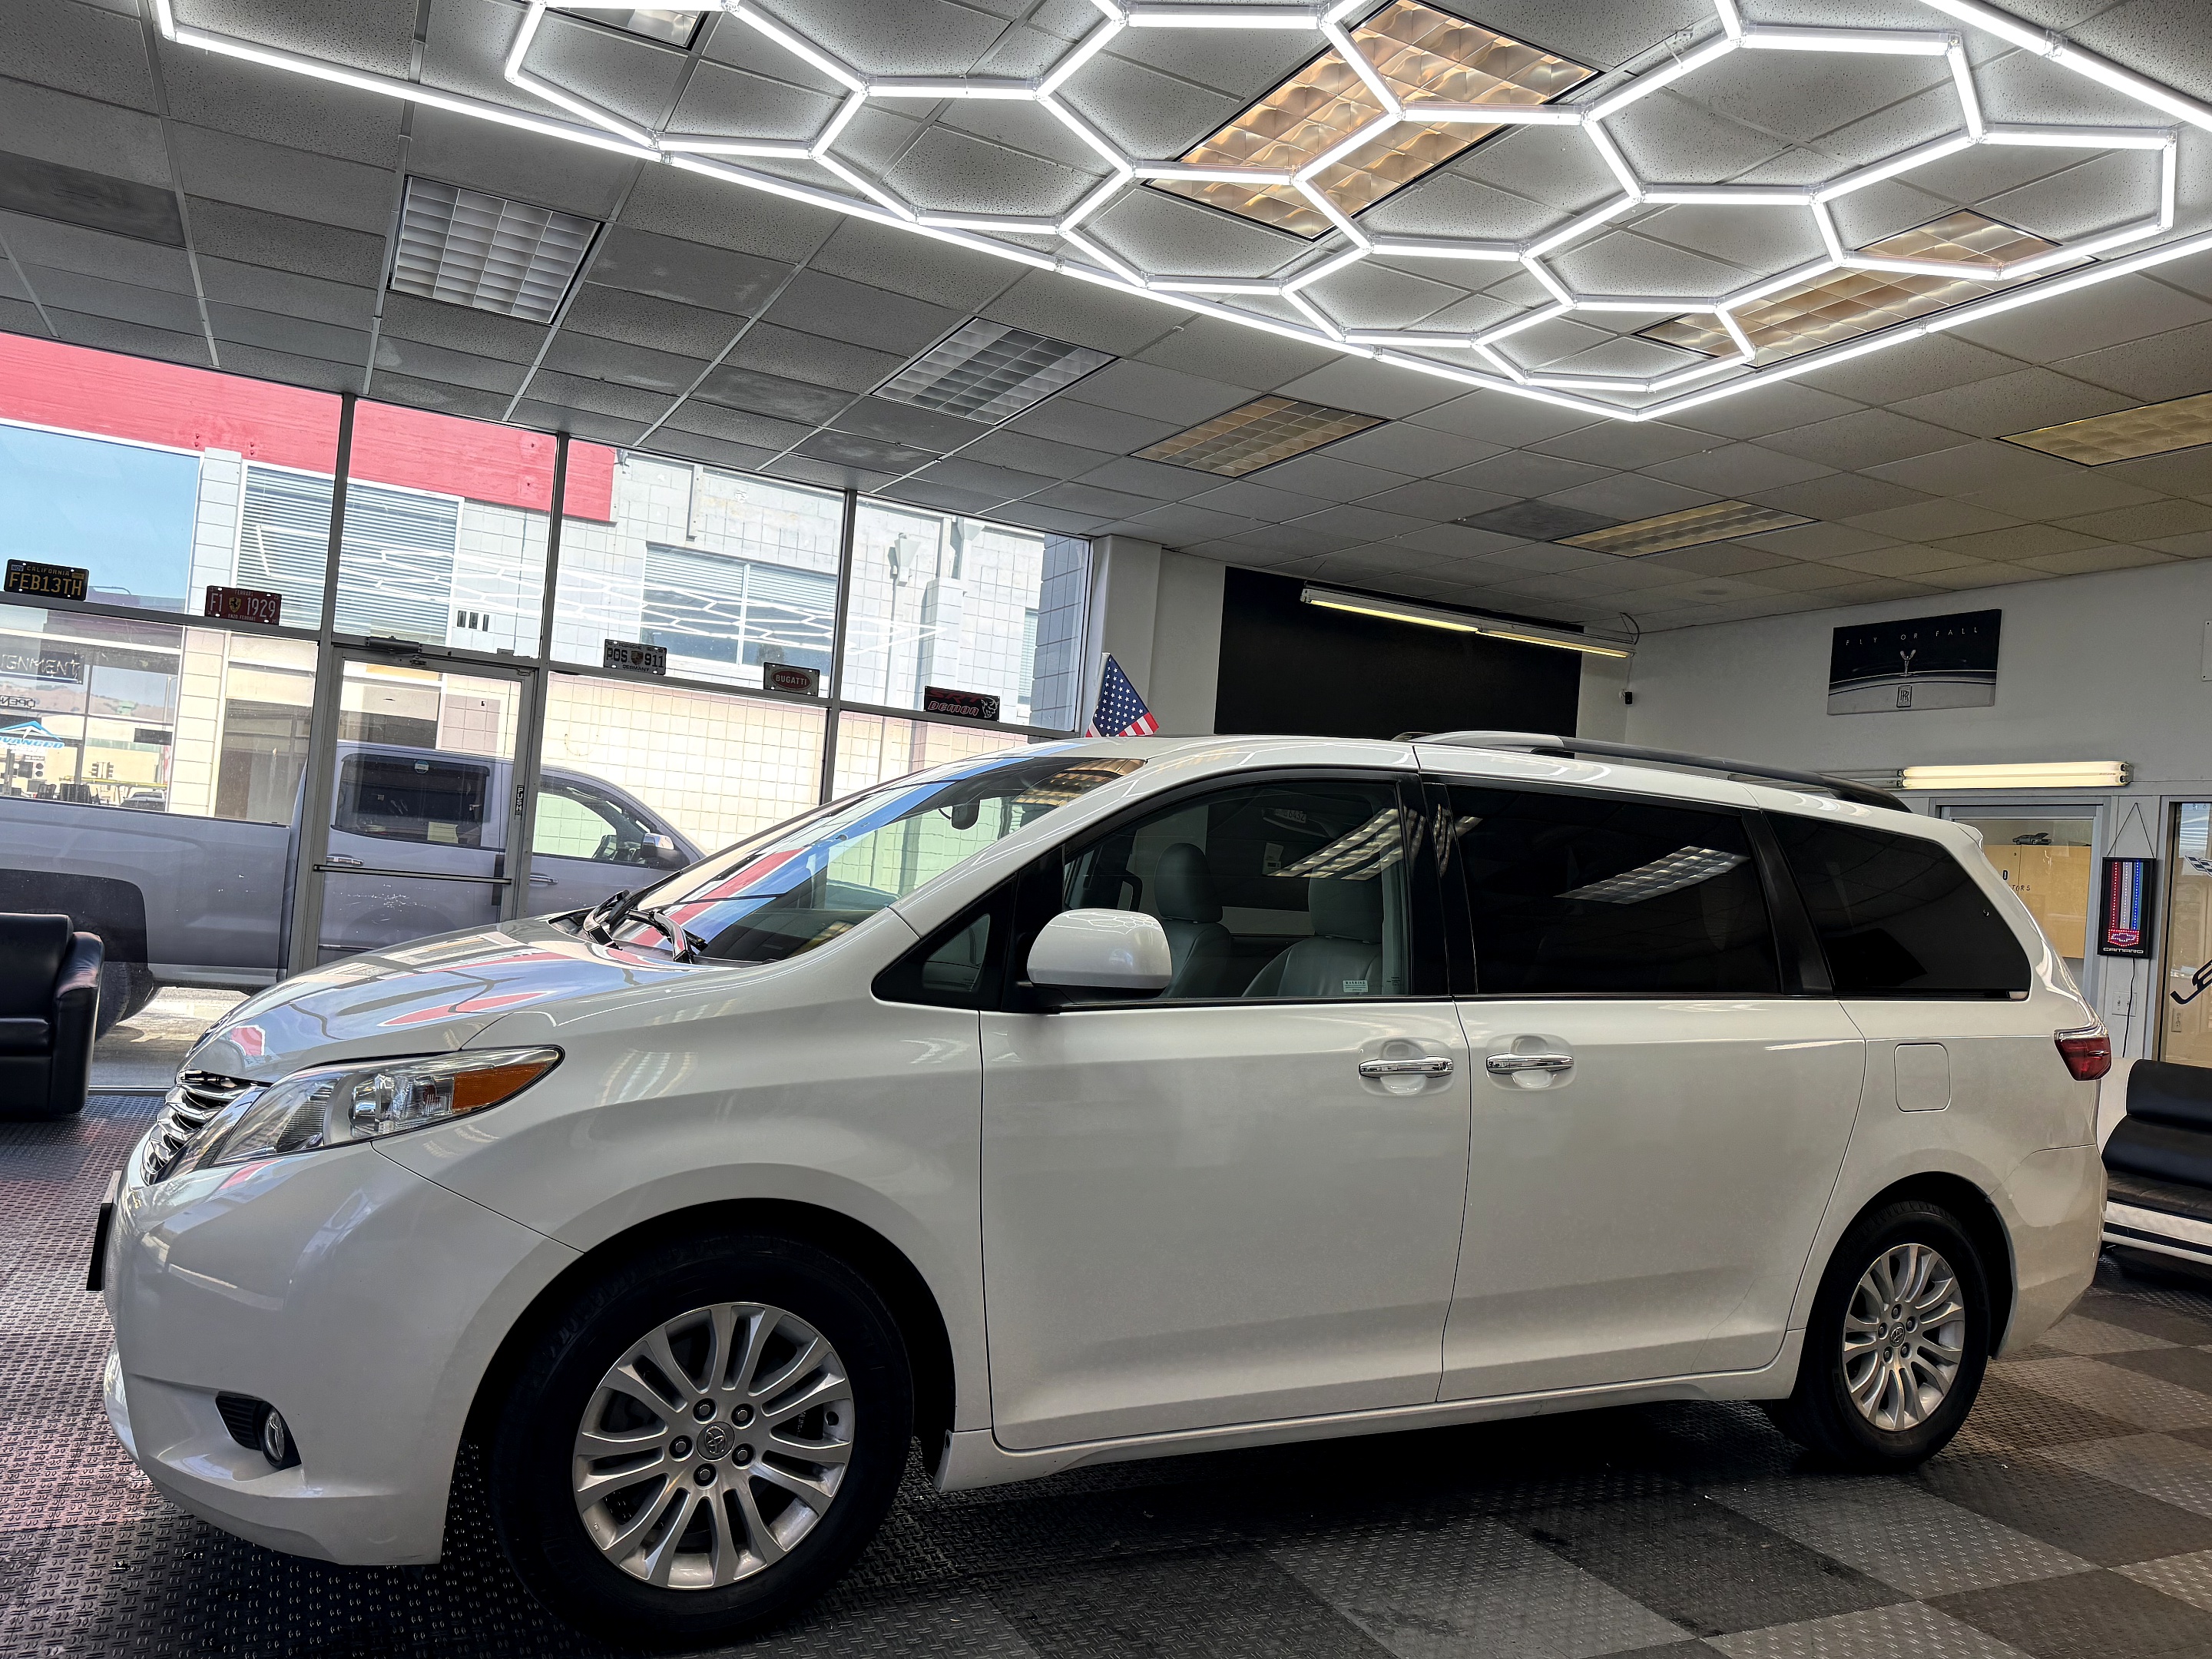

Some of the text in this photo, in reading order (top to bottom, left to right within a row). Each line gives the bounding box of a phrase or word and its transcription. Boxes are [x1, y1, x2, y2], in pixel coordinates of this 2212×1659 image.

[27, 566, 70, 576] CALIFORNIA
[8, 572, 82, 595] FEB13TH
[210, 593, 276, 618] F1 1929
[1846, 637, 1877, 646] FLY
[1936, 627, 1978, 637] FALL
[607, 647, 664, 667] POS 911
[776, 674, 807, 686] BUGATTI
[926, 689, 985, 704] SRT
[0, 737, 64, 748] VANCED
